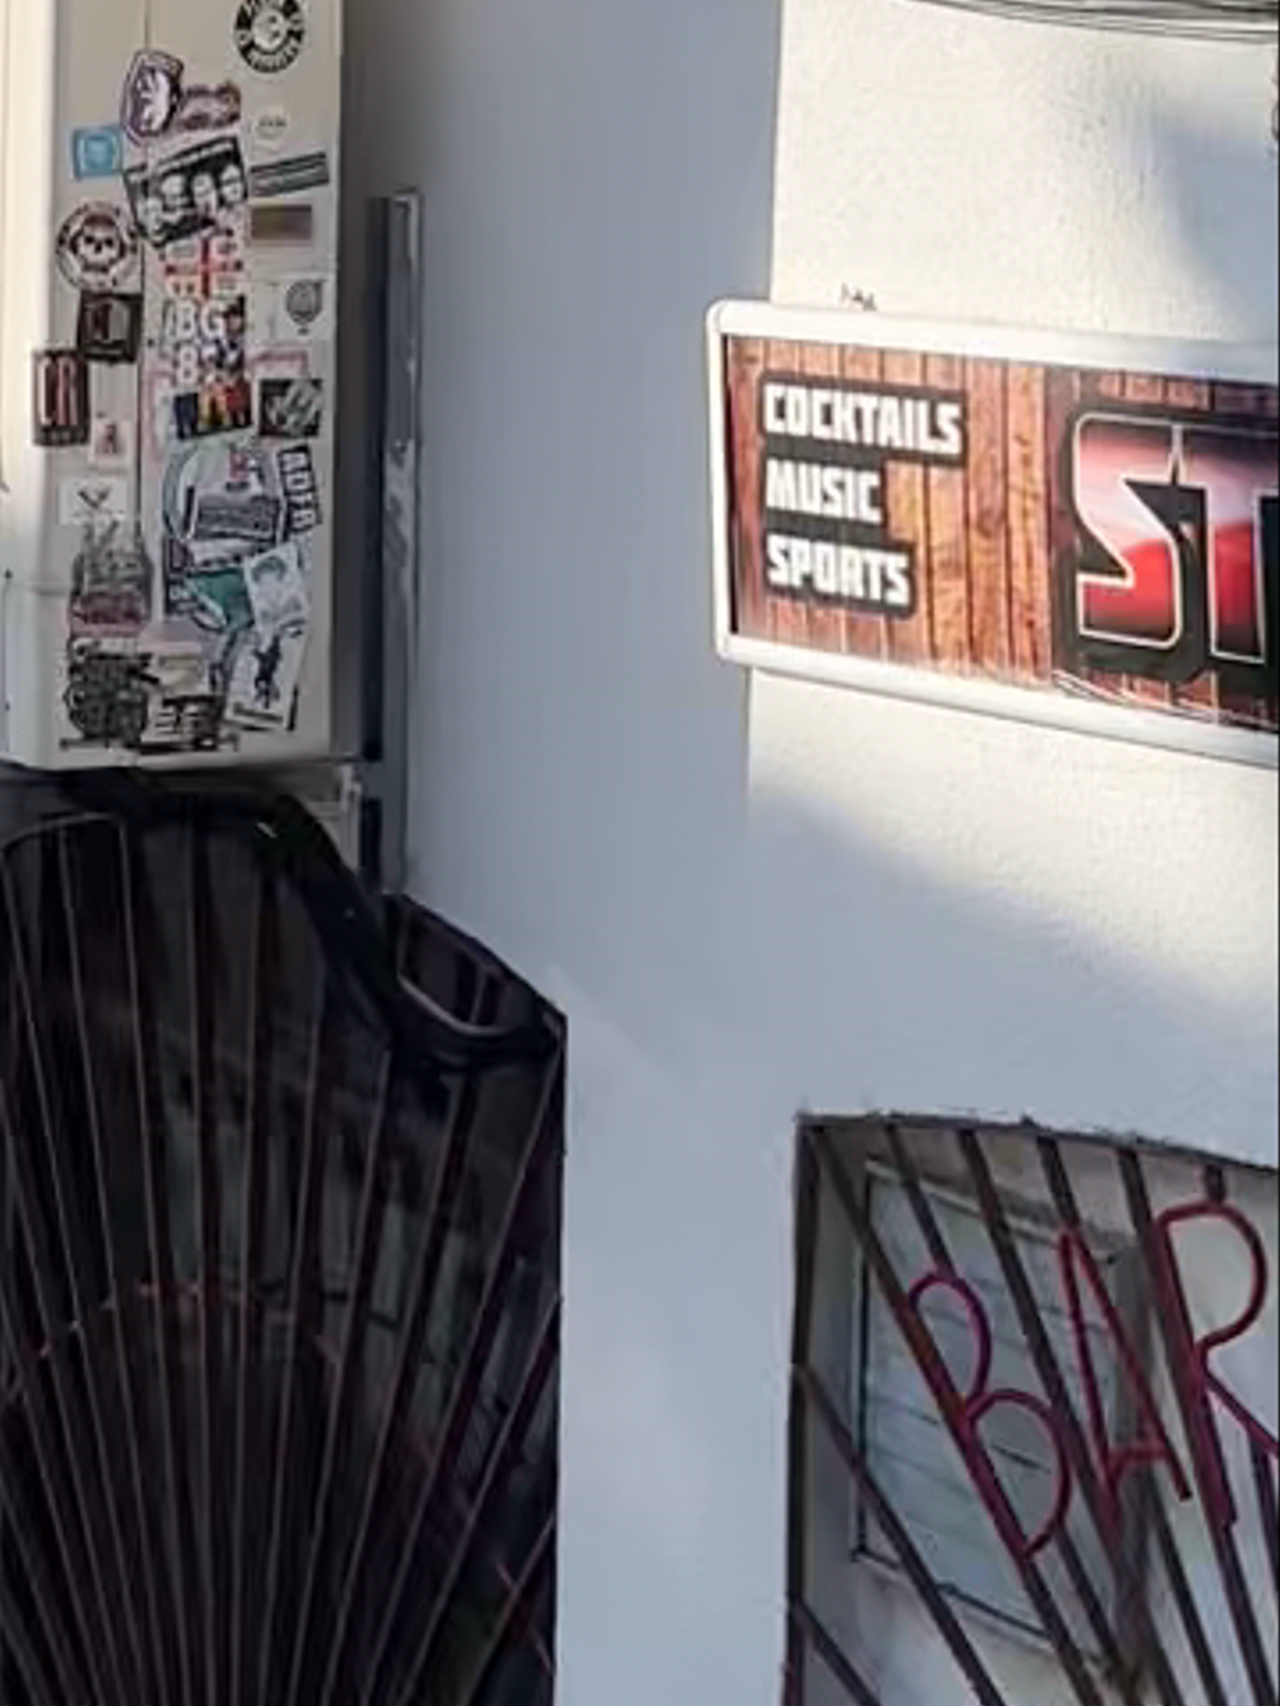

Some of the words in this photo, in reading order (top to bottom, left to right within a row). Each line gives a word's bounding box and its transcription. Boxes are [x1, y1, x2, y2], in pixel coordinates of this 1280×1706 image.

[764, 383, 962, 455] COCKTAILS
[766, 457, 882, 525] MUSIC
[766, 534, 911, 607] SPORTS
[907, 1198, 1278, 1566] BAR
